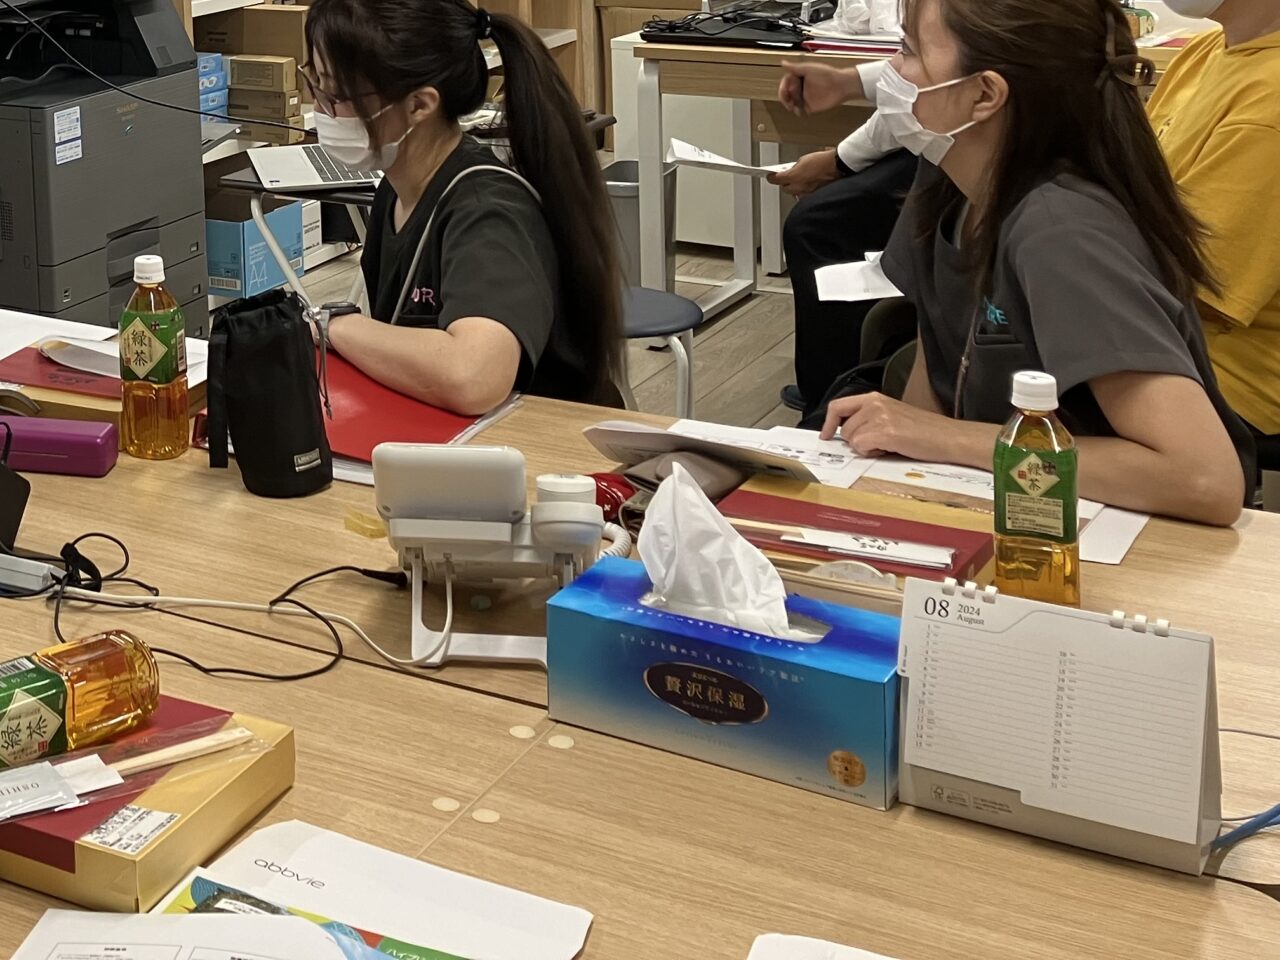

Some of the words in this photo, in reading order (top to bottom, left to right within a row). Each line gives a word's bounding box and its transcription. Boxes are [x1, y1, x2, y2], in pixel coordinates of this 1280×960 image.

[249, 261, 269, 291] A4
[131, 329, 148, 367] 緑茶
[1028, 462, 1042, 491] 緑茶
[924, 596, 950, 619] 08
[957, 603, 981, 617] 2024
[956, 613, 985, 626] August
[663, 675, 747, 711] 贅沢保湿
[1, 714, 48, 751] 緑茶
[253, 858, 326, 890] abbvie
